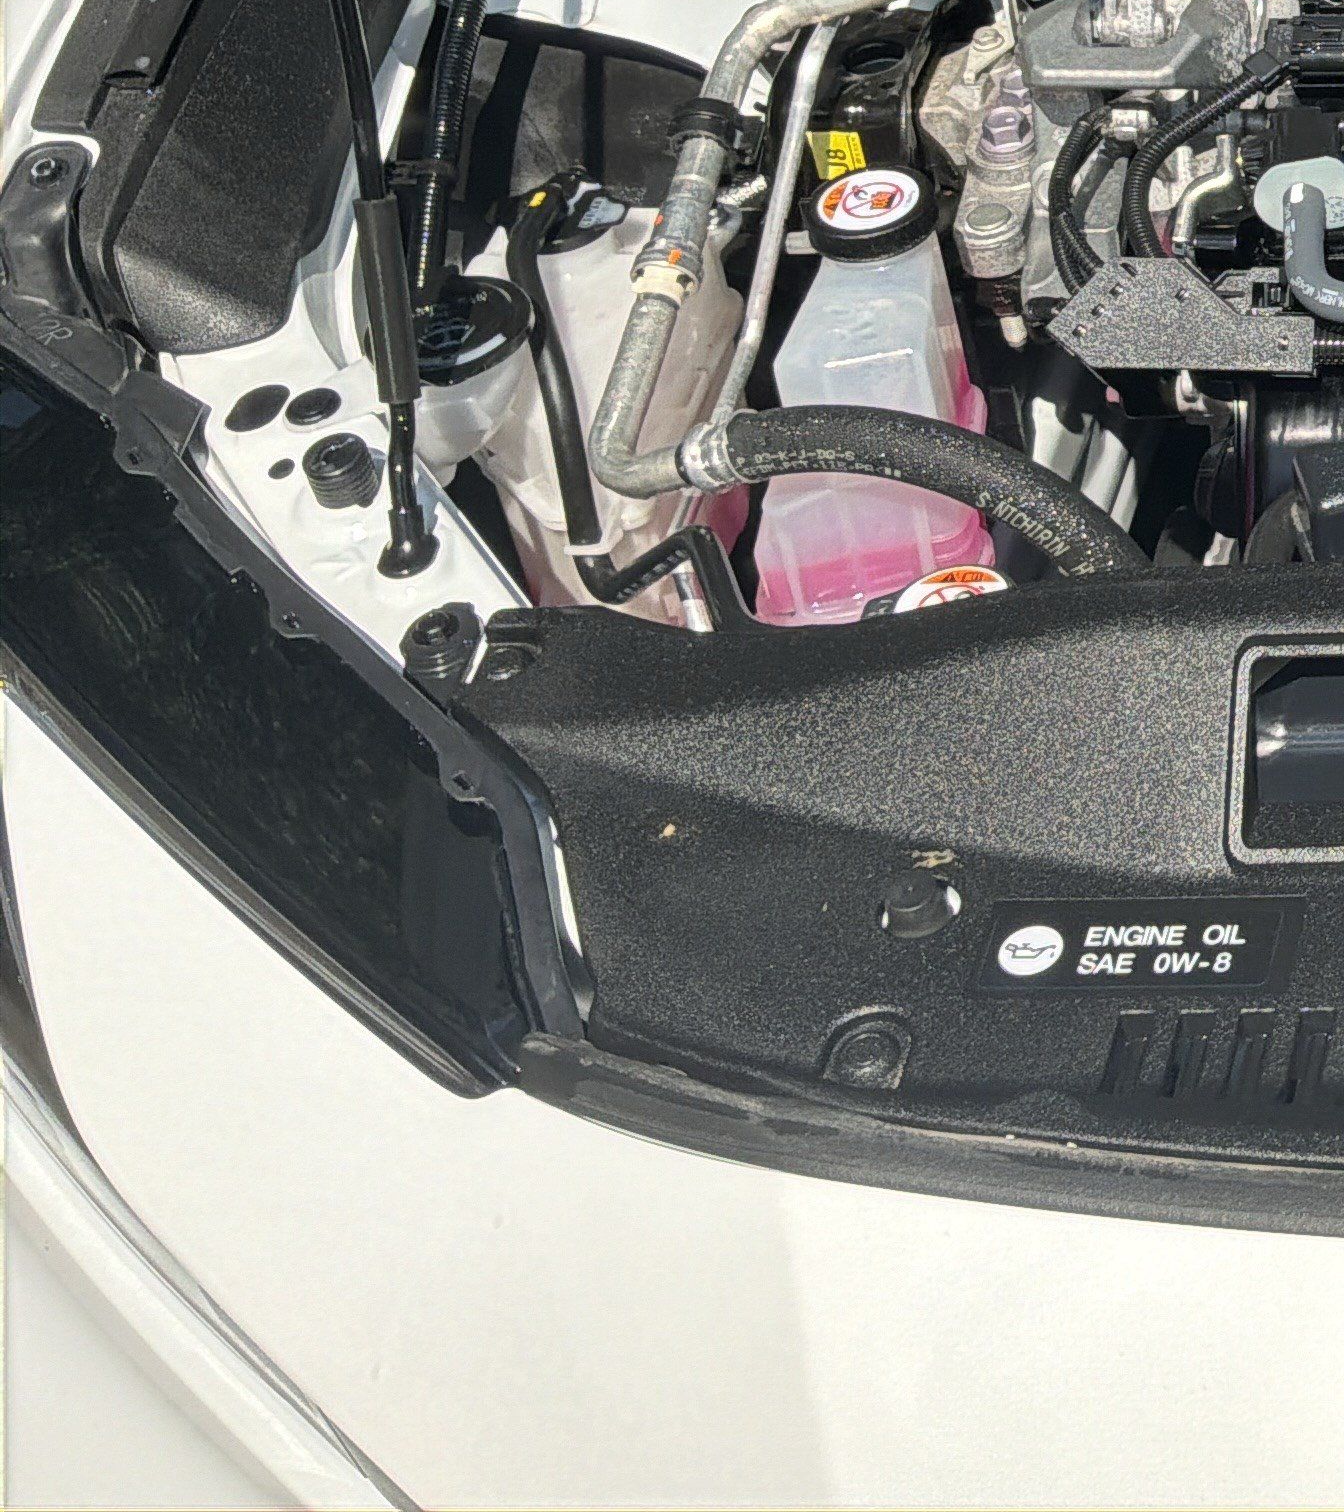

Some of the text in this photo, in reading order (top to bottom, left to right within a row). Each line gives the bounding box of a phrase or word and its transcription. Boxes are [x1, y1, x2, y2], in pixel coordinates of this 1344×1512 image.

[991, 500, 1071, 557] NICHIRIN
[1084, 924, 1246, 947] ENGINE OIL
[1076, 952, 1232, 975] SAE 0W-8
